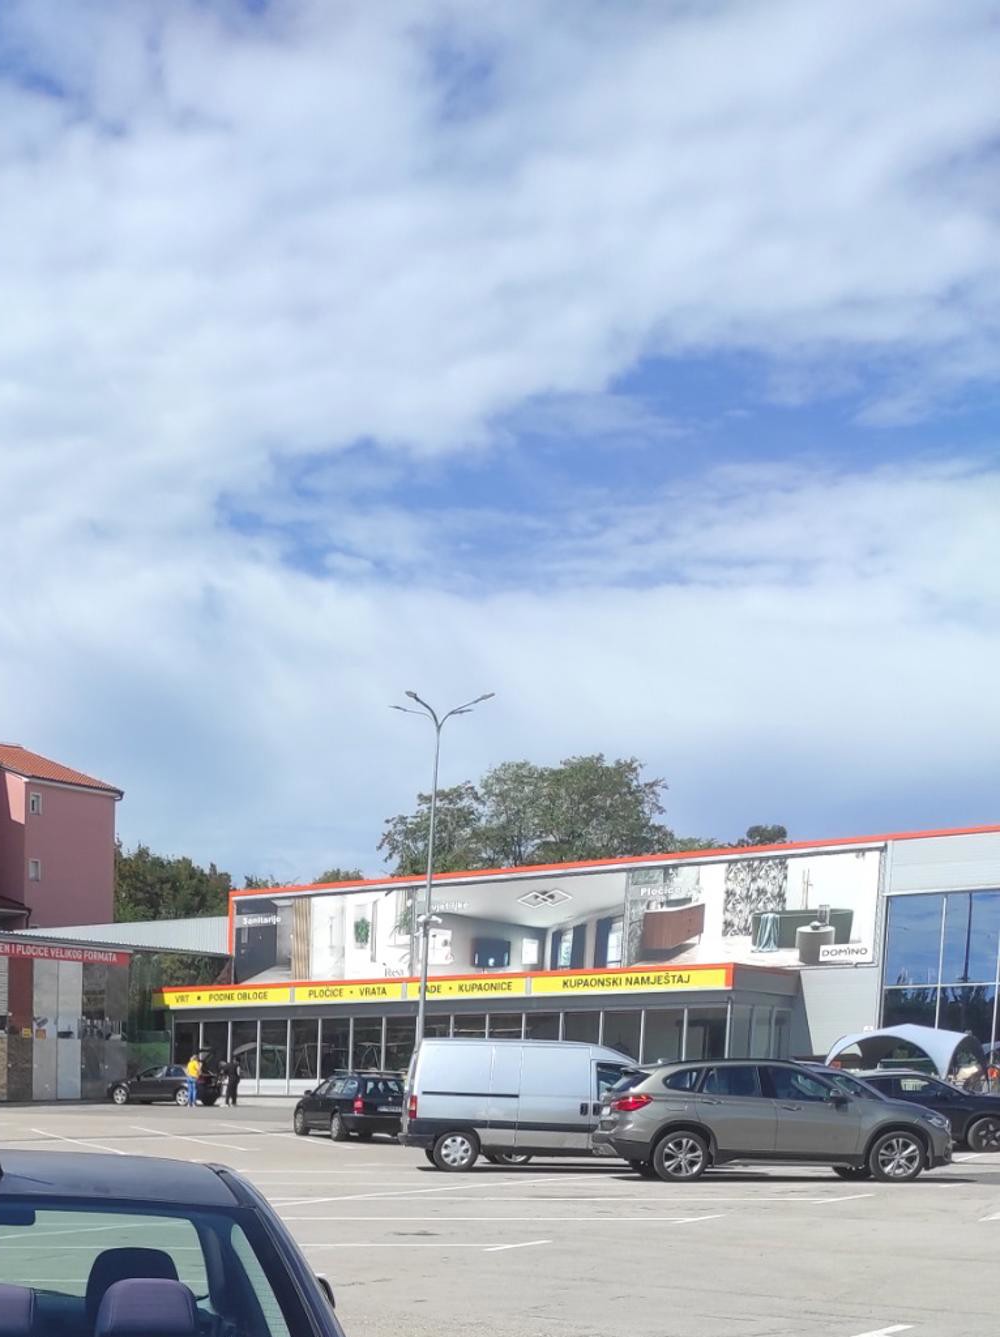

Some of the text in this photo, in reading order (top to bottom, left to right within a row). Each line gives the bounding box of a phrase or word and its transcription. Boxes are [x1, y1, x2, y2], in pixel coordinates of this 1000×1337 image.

[50, 947, 82, 960] VELIKOG
[83, 950, 118, 962] FORMATA
[562, 972, 691, 989] KUPAONSKI NAMJEŠTAJ
[360, 986, 388, 997] VRATA
[418, 981, 513, 994] ADE KUPAONICE
[175, 991, 269, 1003] VRT PODNE OBLOGE
